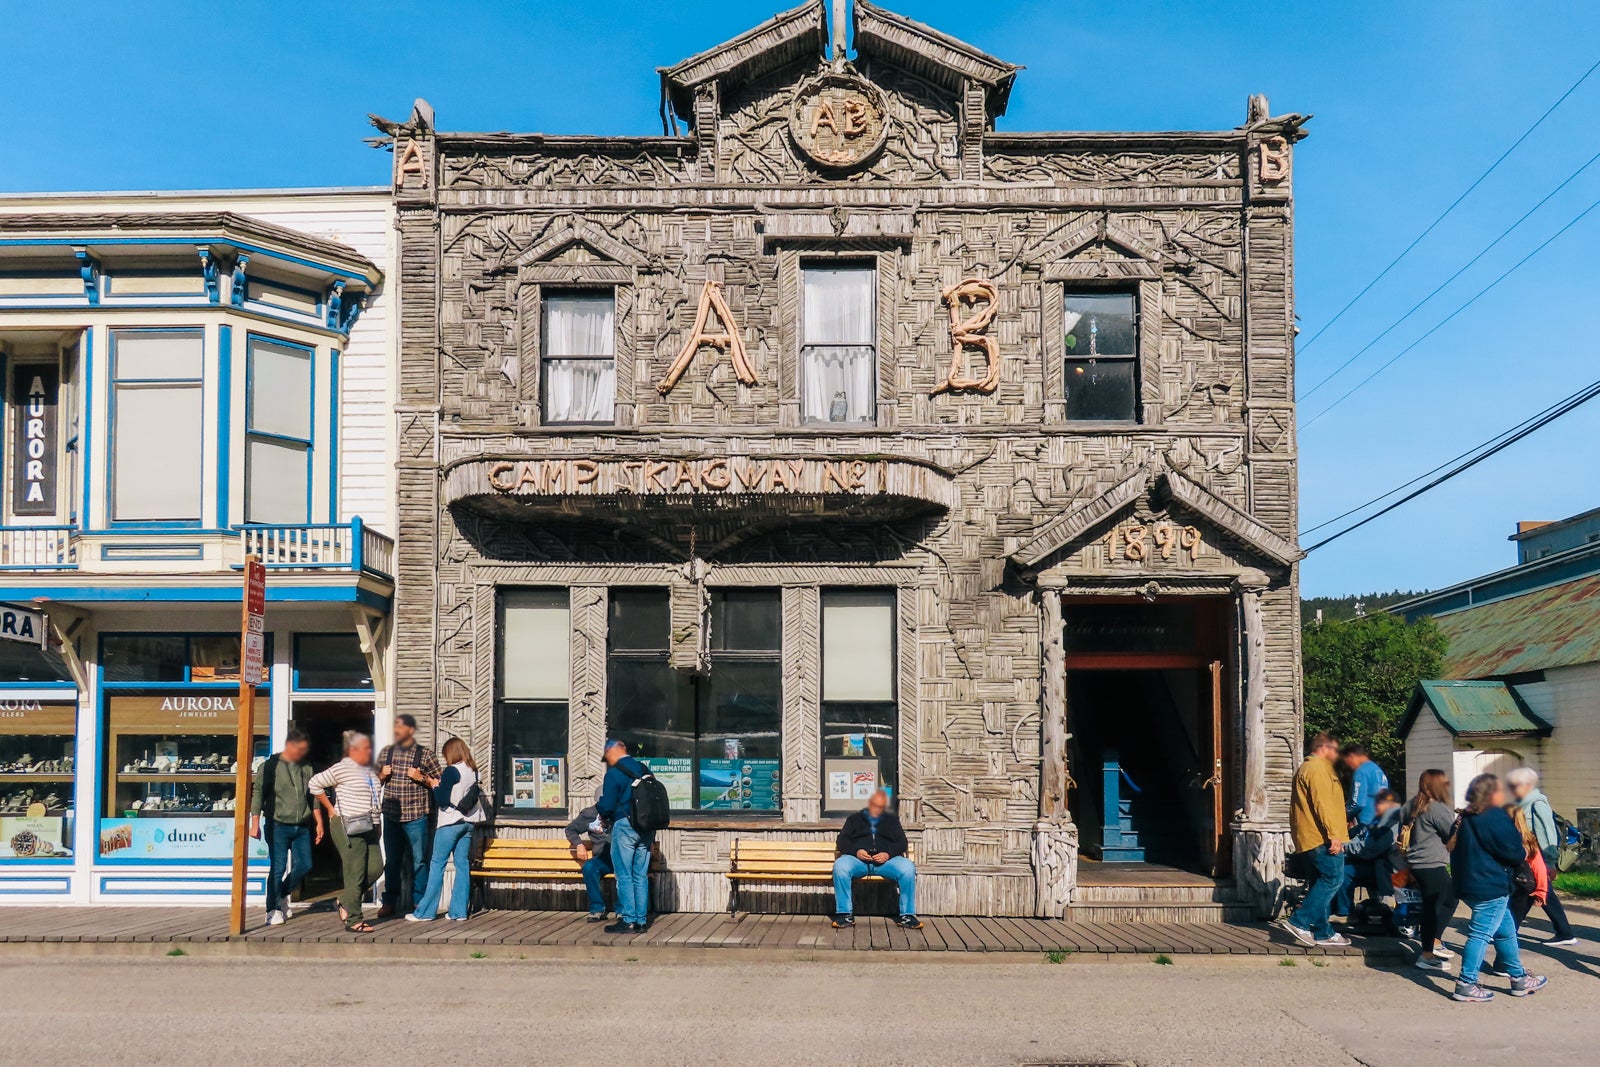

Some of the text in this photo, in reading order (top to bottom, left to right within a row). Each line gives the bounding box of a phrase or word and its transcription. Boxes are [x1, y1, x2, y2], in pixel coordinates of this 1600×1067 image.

[396, 138, 427, 187] A
[1260, 135, 1289, 180] B
[656, 278, 1000, 395] A B
[26, 376, 46, 502] AURORA
[488, 459, 600, 493] CAMP
[614, 458, 804, 493] SKAGWAY
[1103, 525, 1201, 561] 1899
[0, 611, 34, 638] RA
[249, 617, 262, 630] END
[247, 655, 262, 664] PARKING
[160, 696, 235, 711] AURORA
[668, 758, 691, 766] VISITOR
[167, 828, 207, 842] dune
